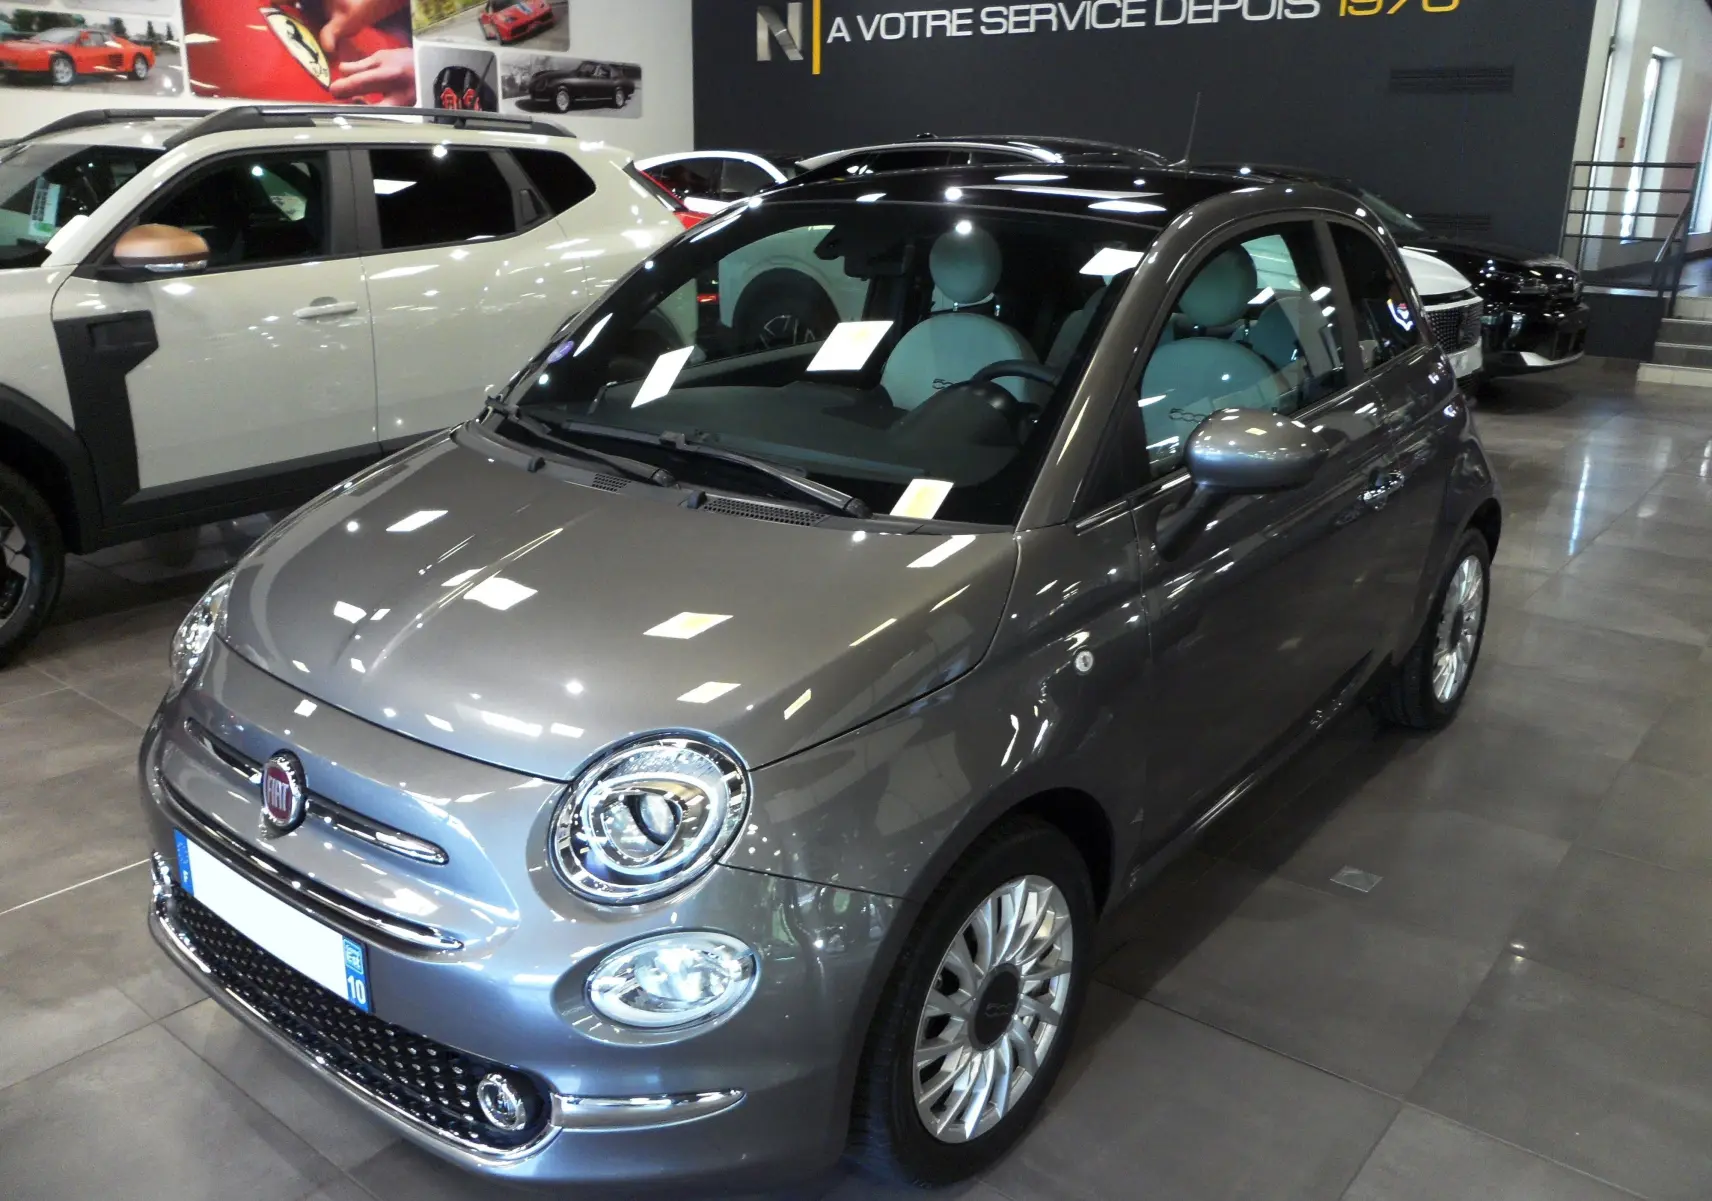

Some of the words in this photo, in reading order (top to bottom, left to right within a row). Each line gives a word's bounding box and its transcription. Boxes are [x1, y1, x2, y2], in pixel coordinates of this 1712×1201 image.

[756, 2, 804, 61] N
[826, 16, 852, 44] A
[856, 8, 975, 42] VOTRE
[980, 0, 1147, 35] SERVICE
[1154, 0, 1320, 27] DEPUIS
[267, 775, 290, 812] FIAT
[347, 975, 367, 1005] 10
